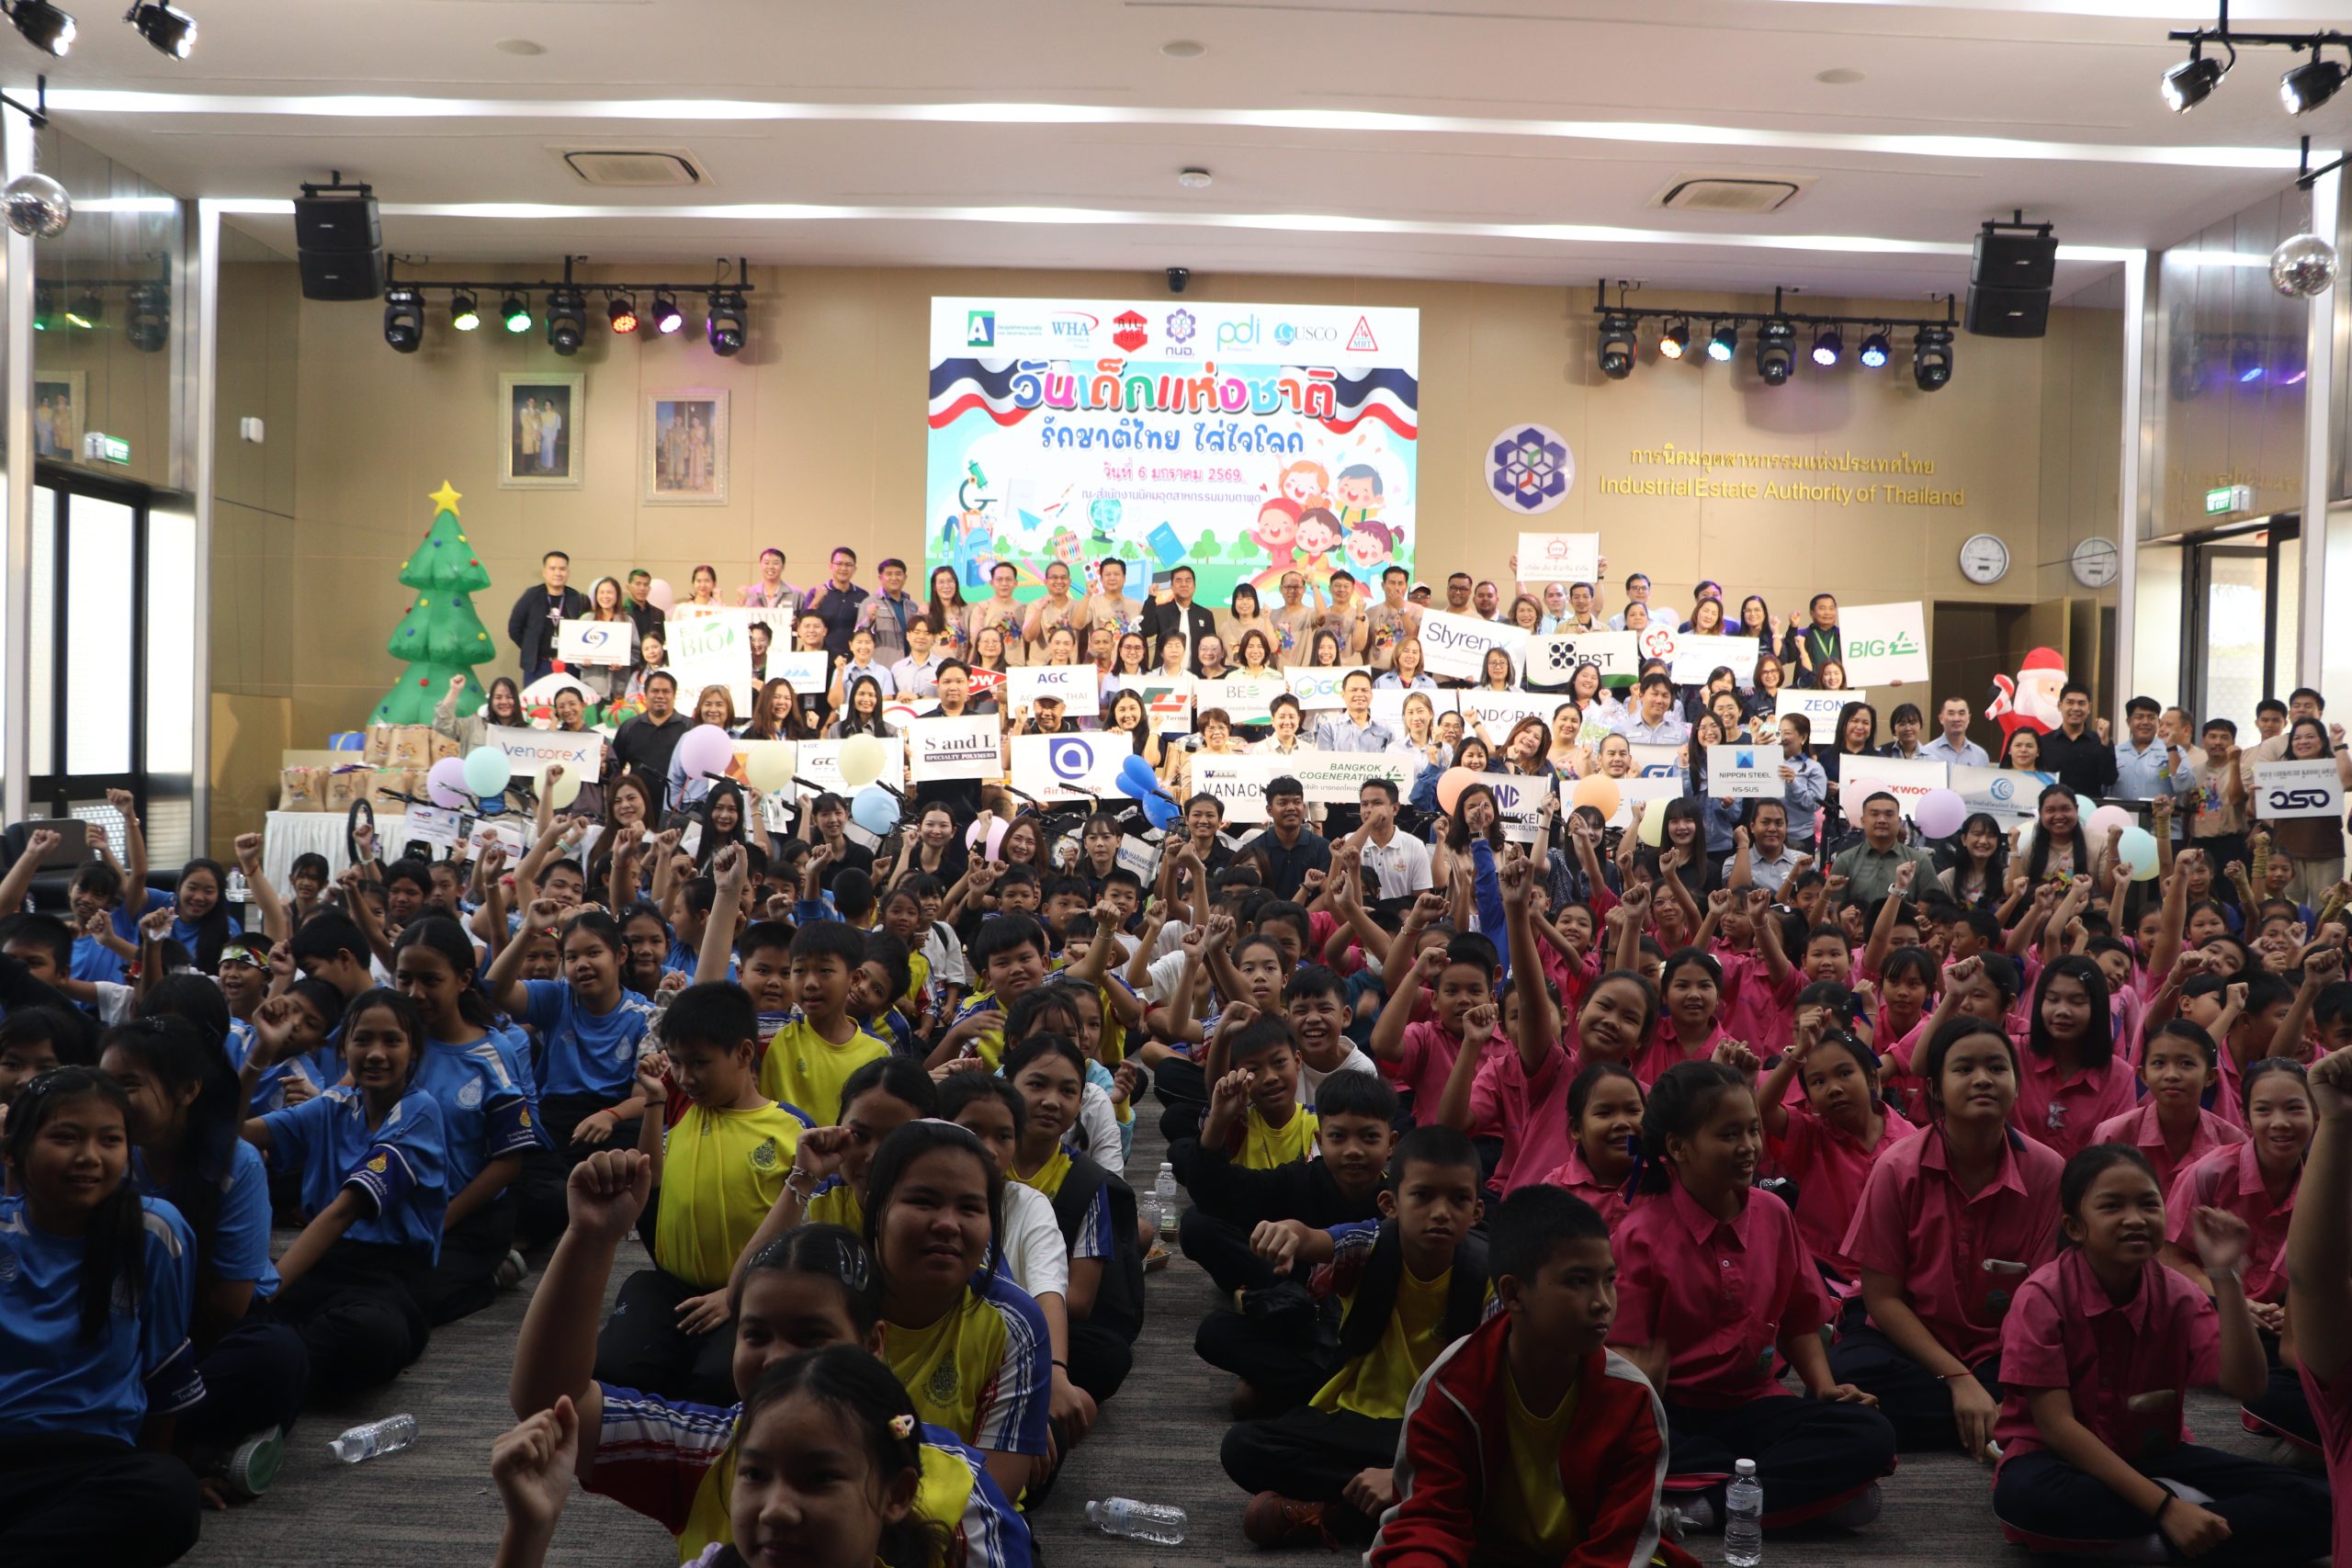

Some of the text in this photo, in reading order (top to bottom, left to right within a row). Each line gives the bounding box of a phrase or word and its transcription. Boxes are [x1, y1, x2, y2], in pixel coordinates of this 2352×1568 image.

[1051, 321, 1090, 336] WHA
[1217, 313, 1261, 353] pdi
[1353, 340, 1371, 348] MRT
[1011, 358, 1337, 417] วันเด็กแห่งชาติ
[1041, 416, 1305, 454] รักชาติไทย ใส่ใจโลก
[1630, 443, 1934, 476] การนิคมอุตสาหกรรมแห่งประเทศไทย
[1102, 458, 1241, 481] วันที่ 6 มกราคม 2569
[1599, 475, 1965, 506] Industrial Estate Authority of Thailand
[1849, 639, 1885, 659] BIG
[968, 674, 998, 687] OW
[1037, 672, 1069, 683] AGC
[1019, 694, 1035, 703] AG
[1804, 699, 1846, 712] ZEON
[924, 735, 996, 751] S and L
[926, 752, 996, 761] SPECIALTY POLYMERS
[1329, 762, 1382, 773] BANGKOK
[1298, 771, 1382, 782] COGENERATION
[1044, 785, 1102, 798] Air Liqide
[1886, 784, 1931, 797] KWOO
